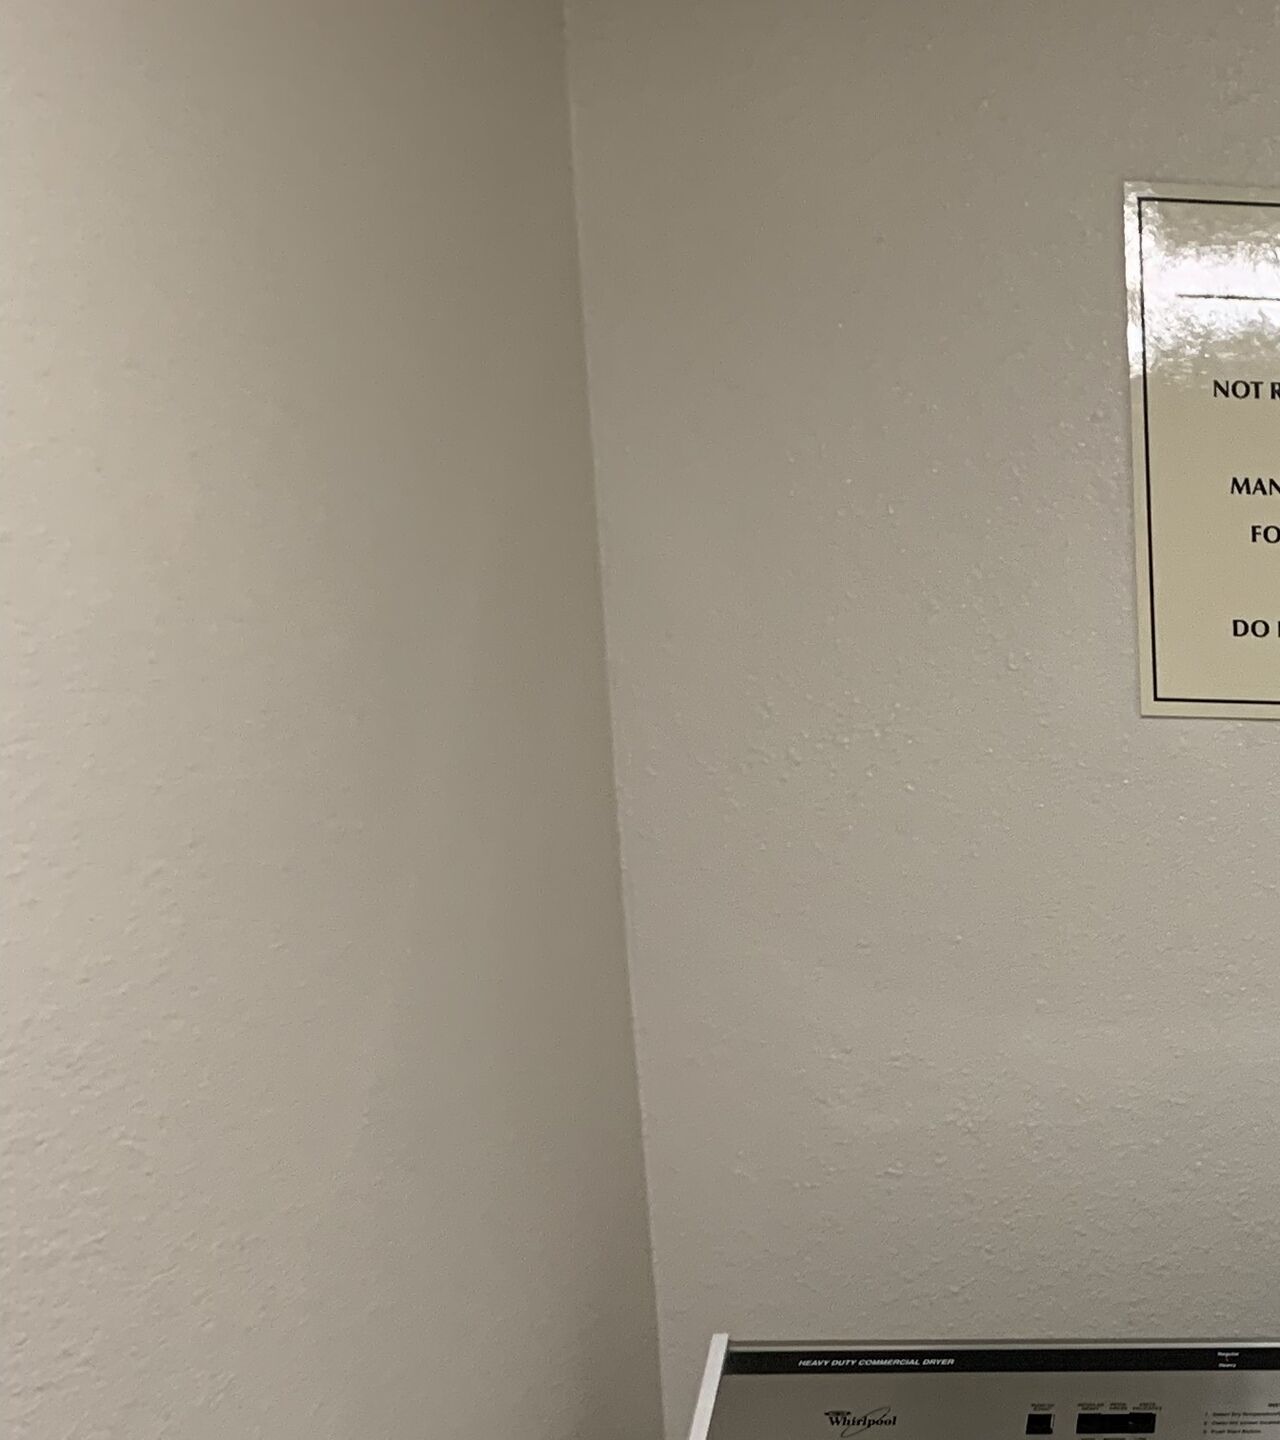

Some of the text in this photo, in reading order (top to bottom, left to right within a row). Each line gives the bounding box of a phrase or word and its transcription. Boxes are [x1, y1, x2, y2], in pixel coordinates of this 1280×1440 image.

[1212, 379, 1265, 400] NOT
[1232, 619, 1270, 639] DO
[798, 1357, 956, 1367] HEAVY DUTY COMMERCIAL DRYER
